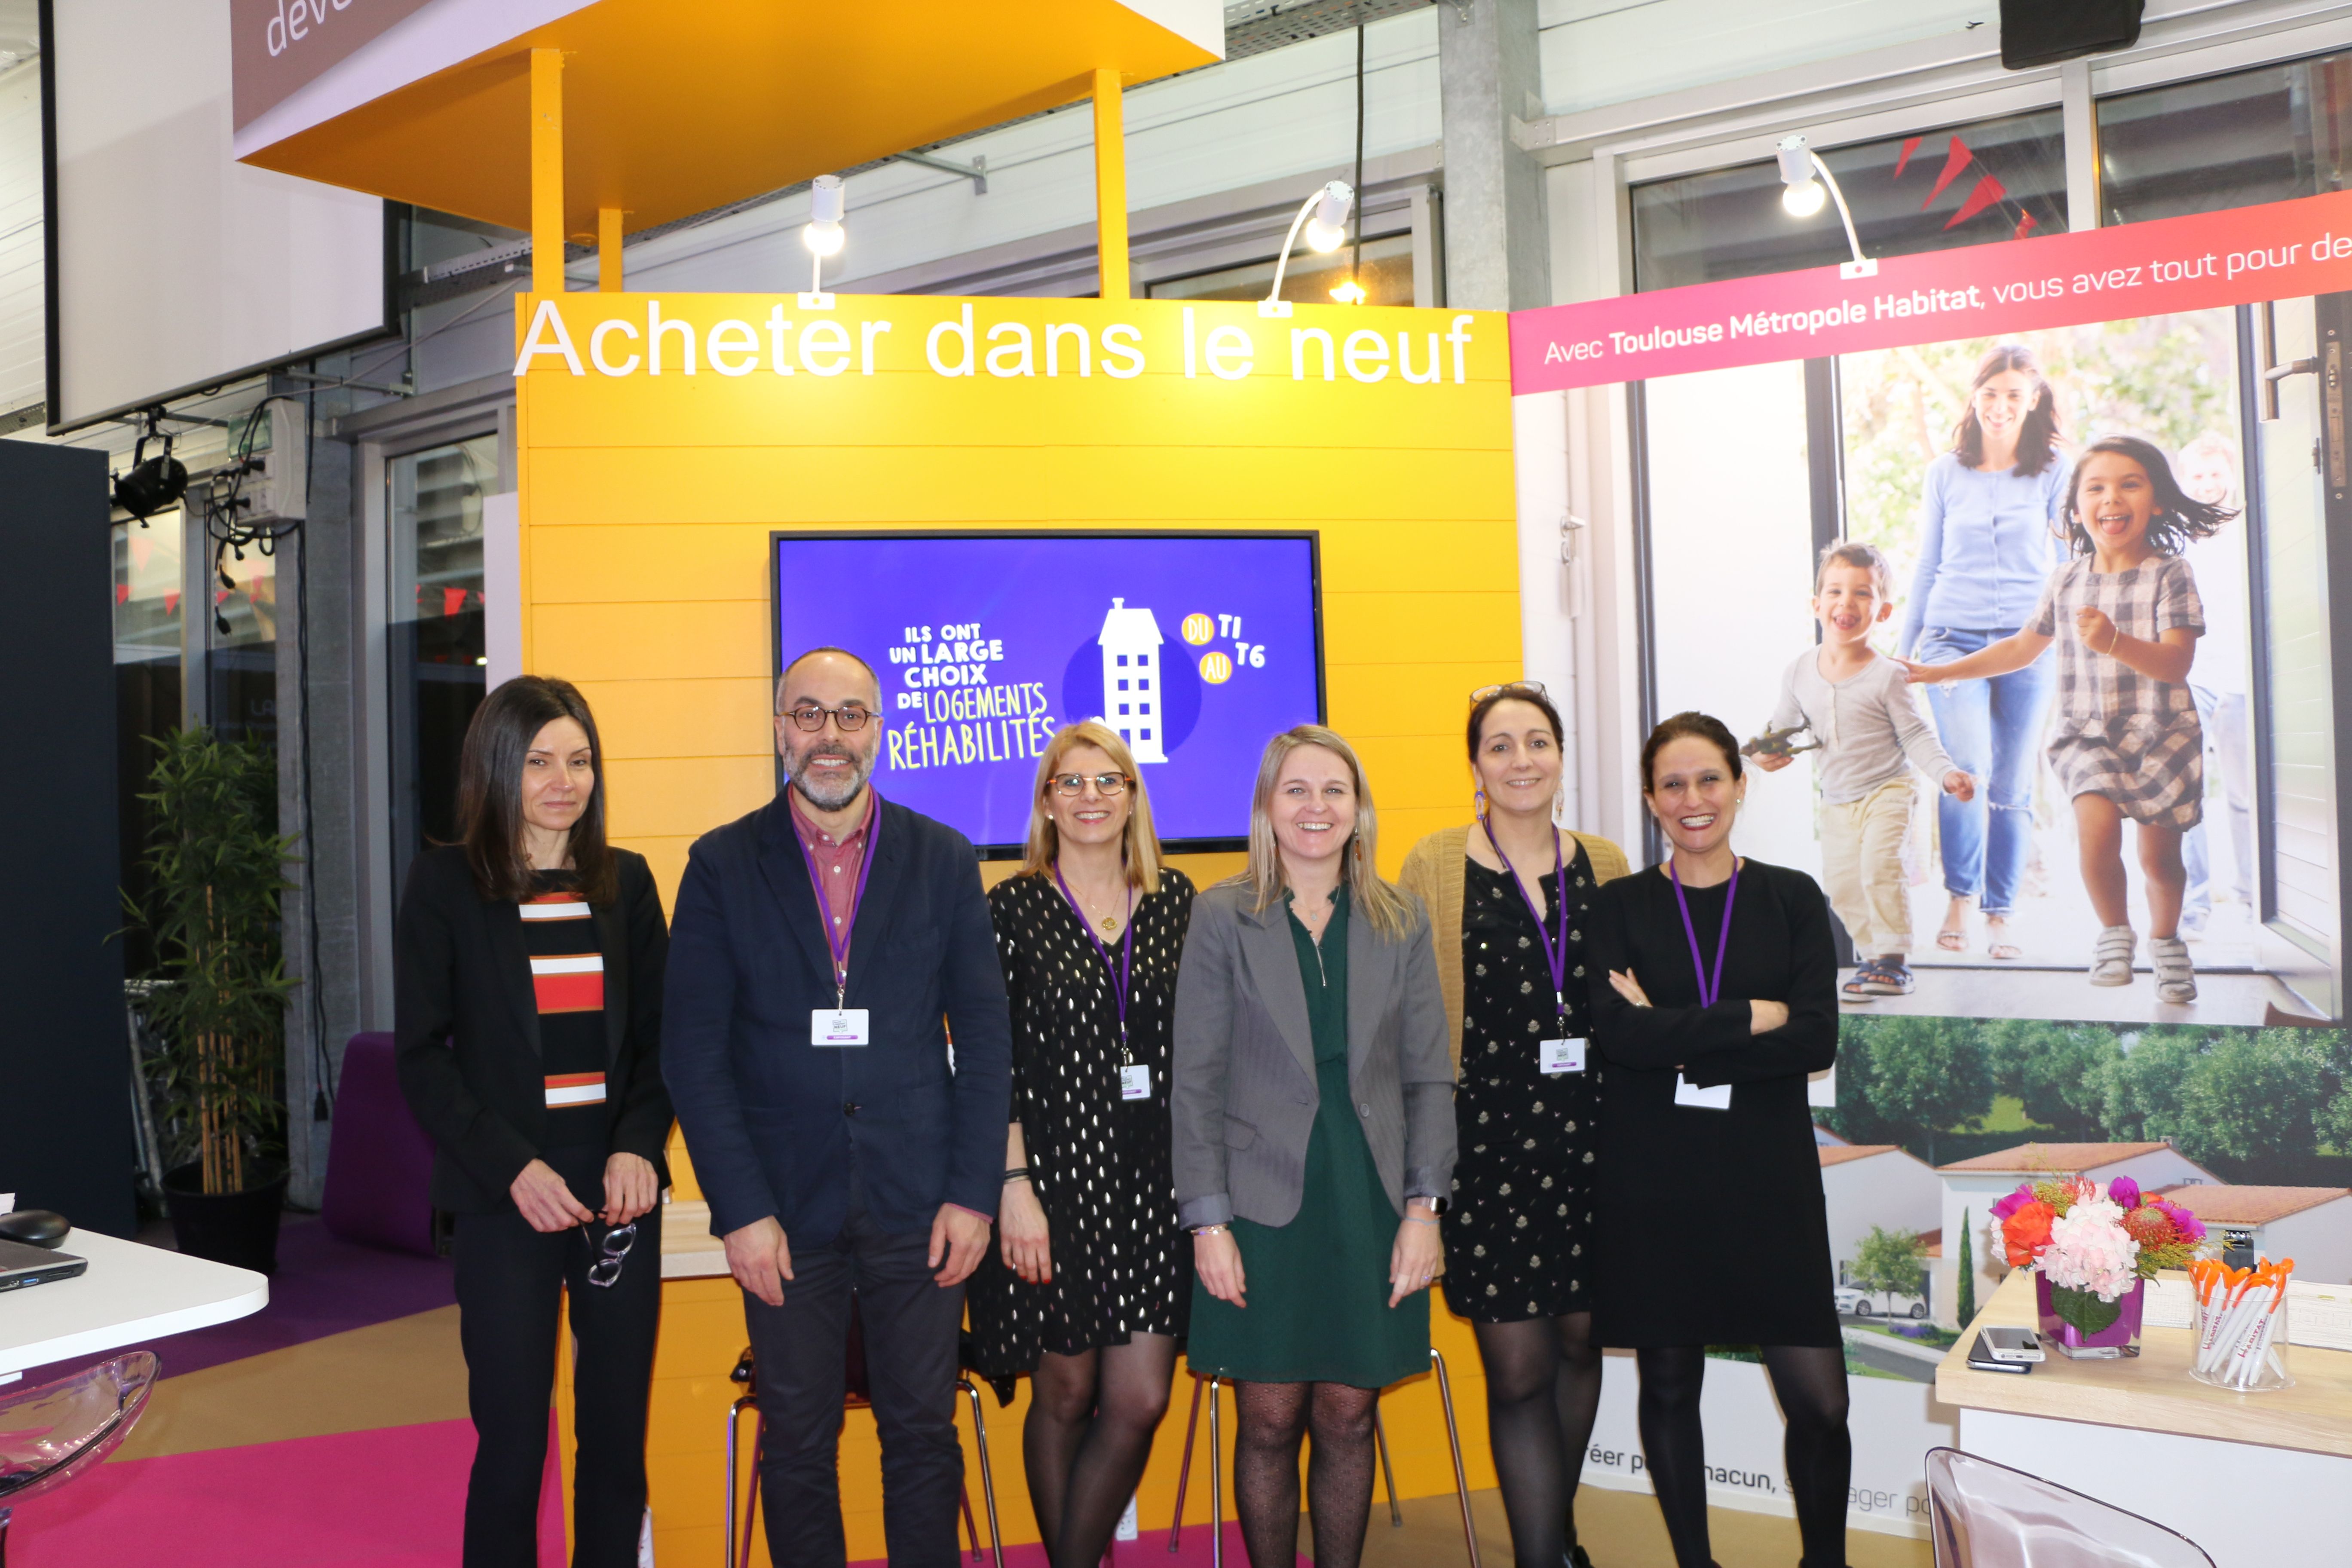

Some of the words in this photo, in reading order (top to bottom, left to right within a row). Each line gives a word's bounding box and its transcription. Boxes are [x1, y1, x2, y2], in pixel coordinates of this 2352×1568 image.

[1544, 340, 1604, 364] Avec
[1609, 323, 1723, 355] Toulouse
[1730, 300, 1866, 339] Métropole
[1874, 286, 1985, 320] Habitat,
[1993, 277, 2063, 304] vous
[2072, 266, 2142, 294] avez
[2150, 253, 2217, 283] tout
[2227, 242, 2302, 280] pour
[513, 300, 892, 377] Acheter
[925, 303, 1146, 378] dans
[1182, 306, 1254, 380] le
[1290, 315, 1473, 384] neuf
[905, 625, 932, 643] ILS
[940, 623, 981, 640] ONT
[1188, 617, 1208, 642] DU
[889, 646, 916, 664] UN
[921, 639, 1004, 664] LARGE
[1205, 655, 1226, 680] AU
[1235, 642, 1265, 668] T6
[904, 663, 988, 688] CHOIX
[897, 691, 923, 709] DE
[924, 682, 1047, 723] LOGEMENTS
[888, 706, 1057, 771] RÉHABILITÉS
